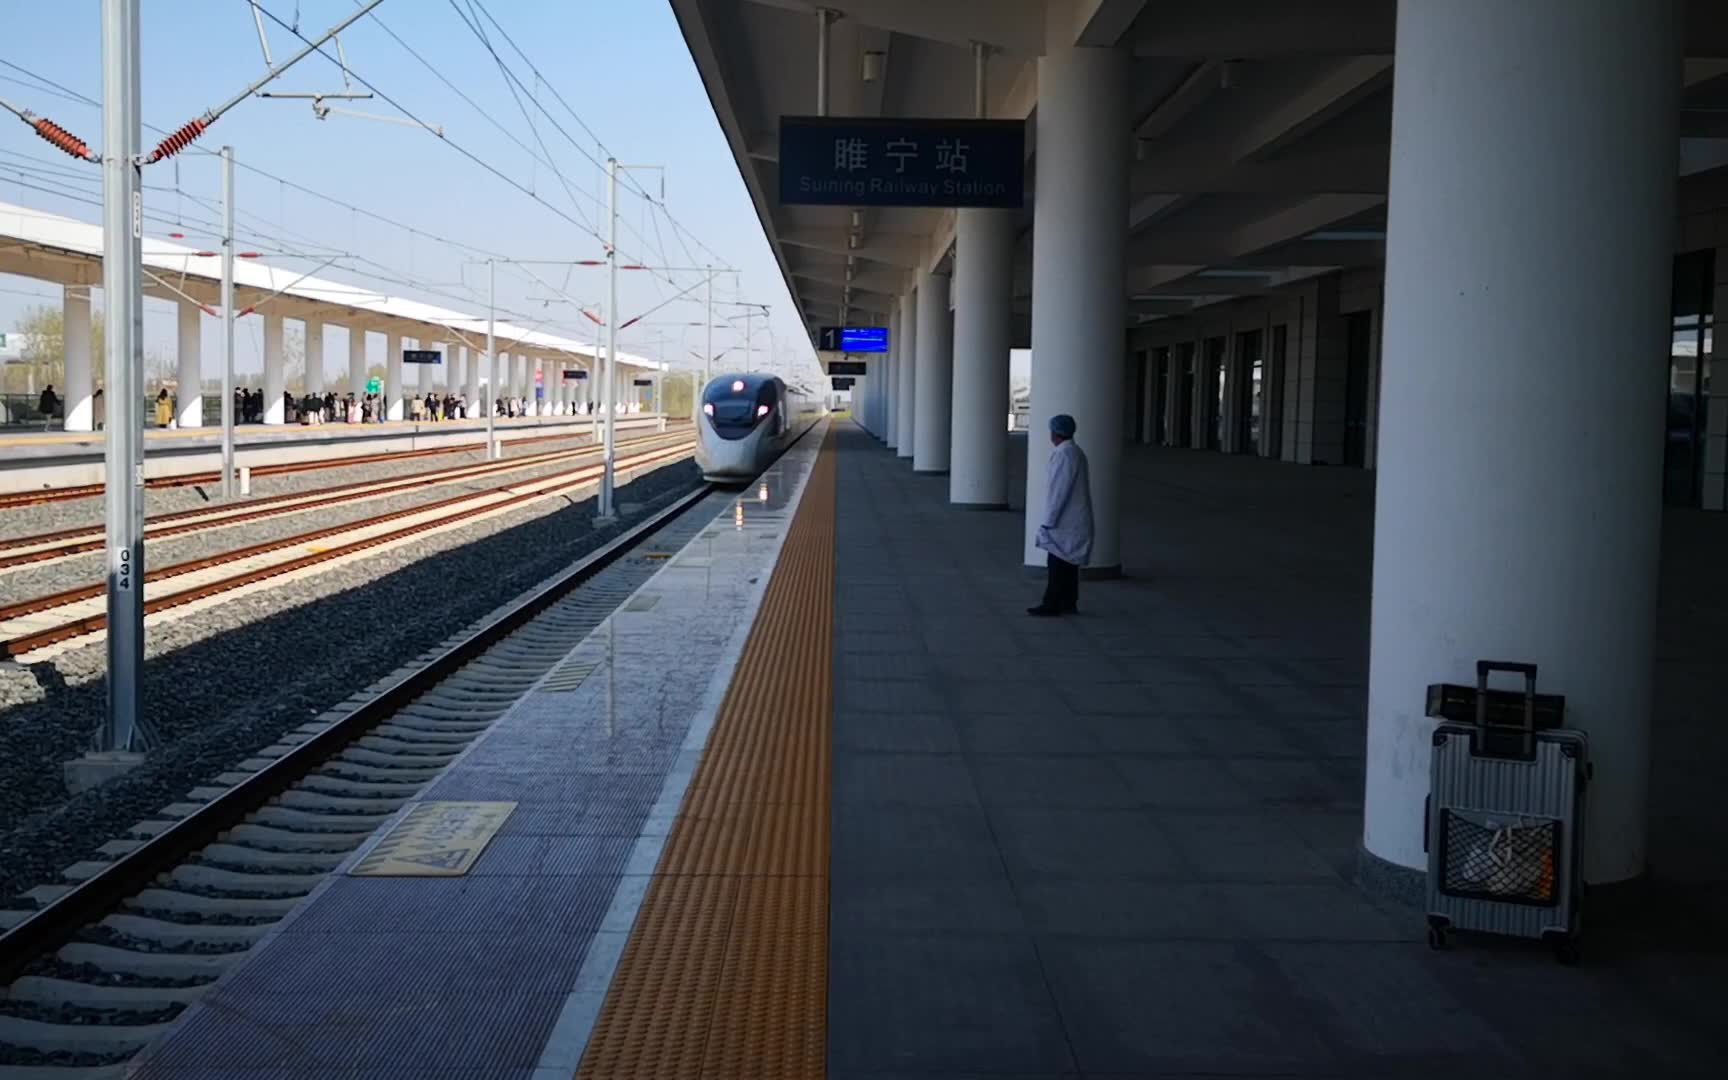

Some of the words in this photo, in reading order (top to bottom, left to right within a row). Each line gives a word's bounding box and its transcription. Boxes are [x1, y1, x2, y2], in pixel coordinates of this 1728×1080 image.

[834, 137, 970, 174] 睢宁站
[800, 175, 865, 196] Suining
[870, 177, 938, 196] Railway
[943, 178, 1007, 195] Station
[825, 329, 835, 349] 1
[120, 549, 130, 590] 034
